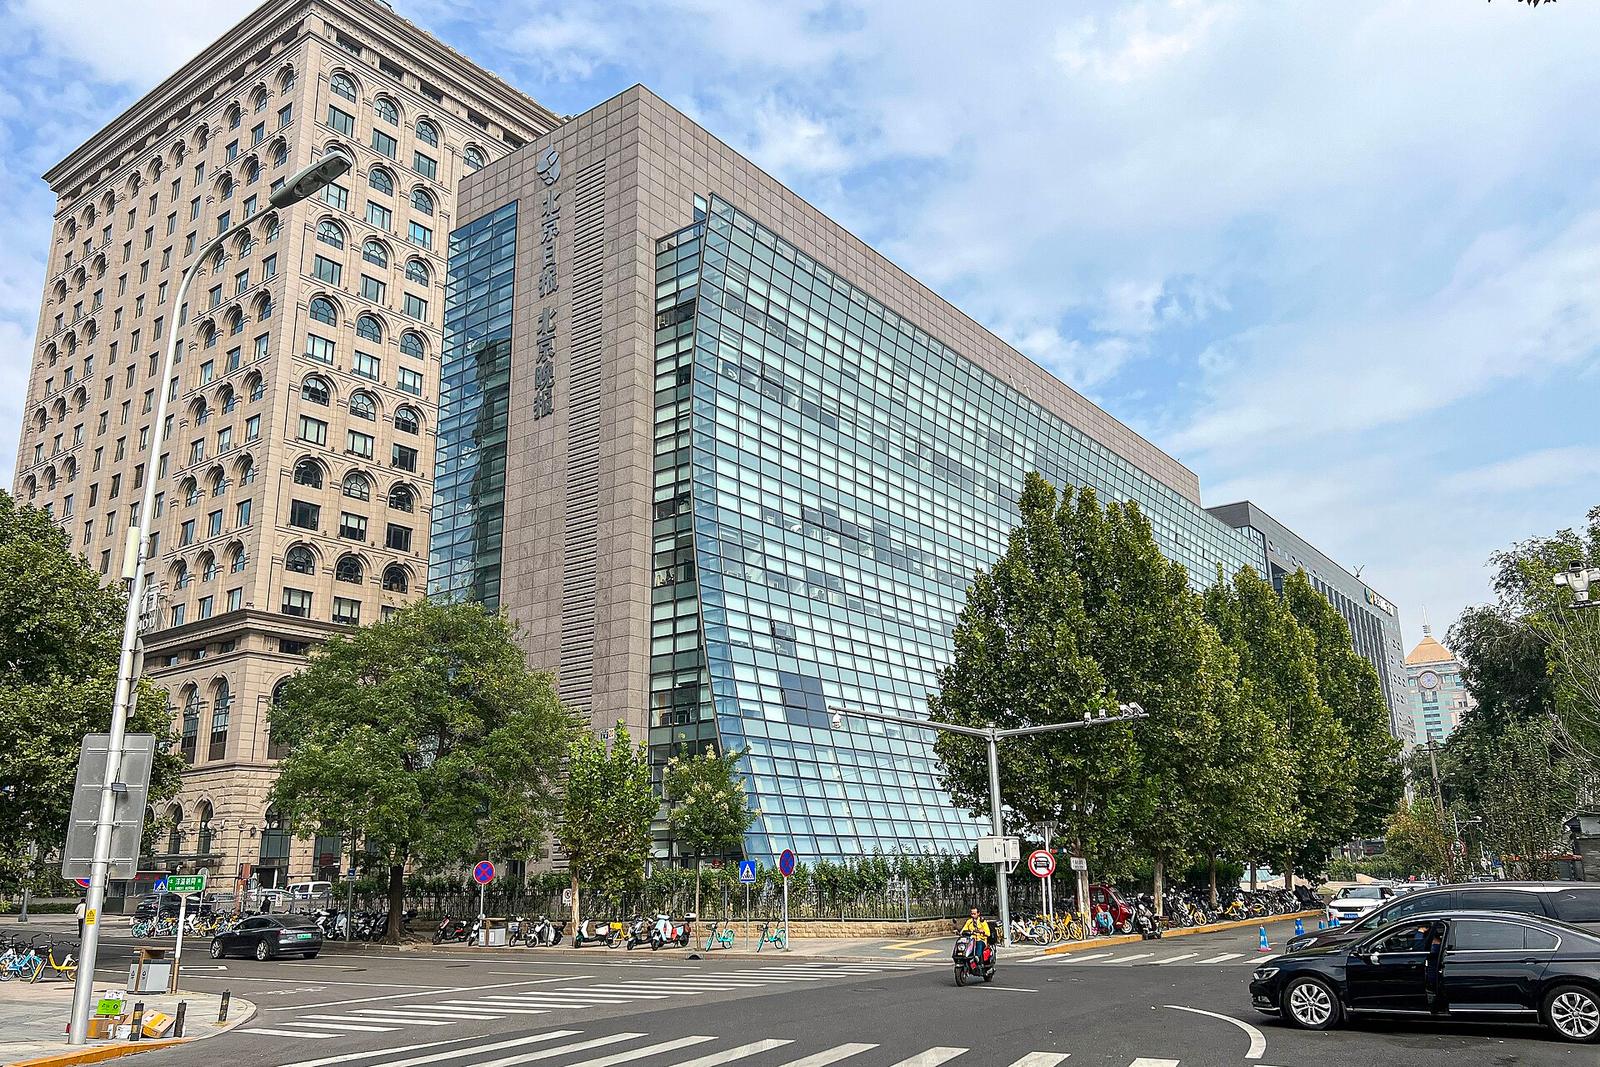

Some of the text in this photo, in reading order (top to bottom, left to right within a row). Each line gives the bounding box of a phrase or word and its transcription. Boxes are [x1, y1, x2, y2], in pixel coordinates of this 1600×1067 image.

[533, 189, 561, 421] 北京日报 北京晚报
